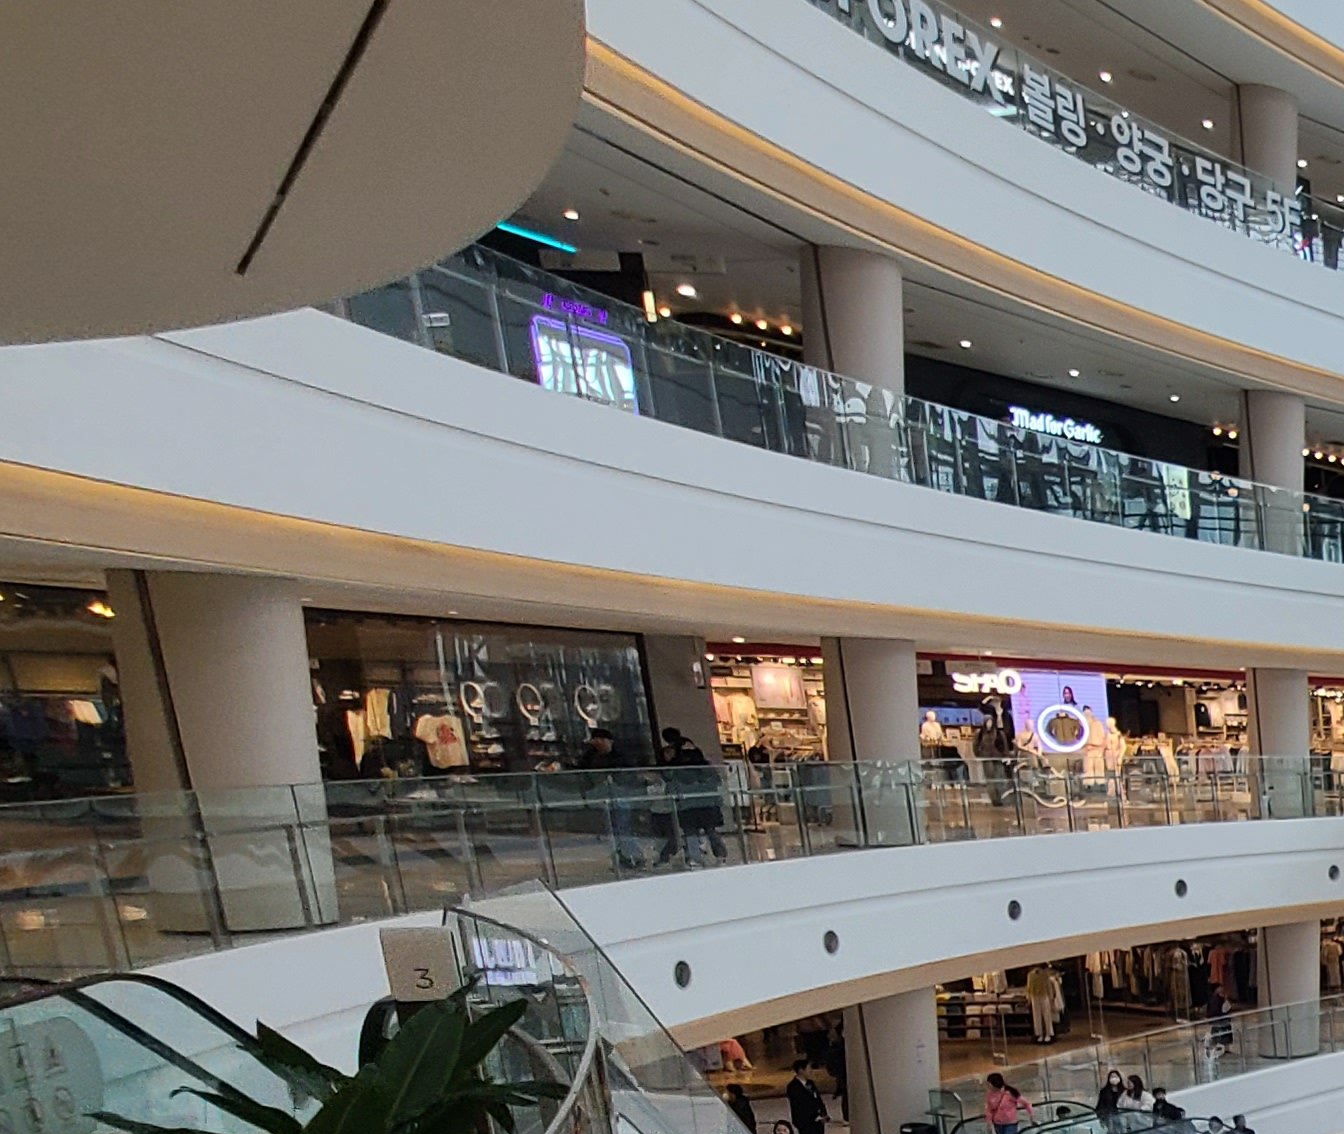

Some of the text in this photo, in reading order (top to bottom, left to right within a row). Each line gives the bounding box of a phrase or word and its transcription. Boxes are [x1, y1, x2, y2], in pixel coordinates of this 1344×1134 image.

[837, 0, 1005, 104] OREX
[1024, 63, 1087, 147] 볼링
[1111, 115, 1173, 187] 양궁
[1195, 156, 1254, 221] 당구
[1266, 190, 1303, 237] 5F
[1009, 405, 1045, 432] Mad
[1045, 413, 1064, 437] for
[413, 967, 434, 989] 3
